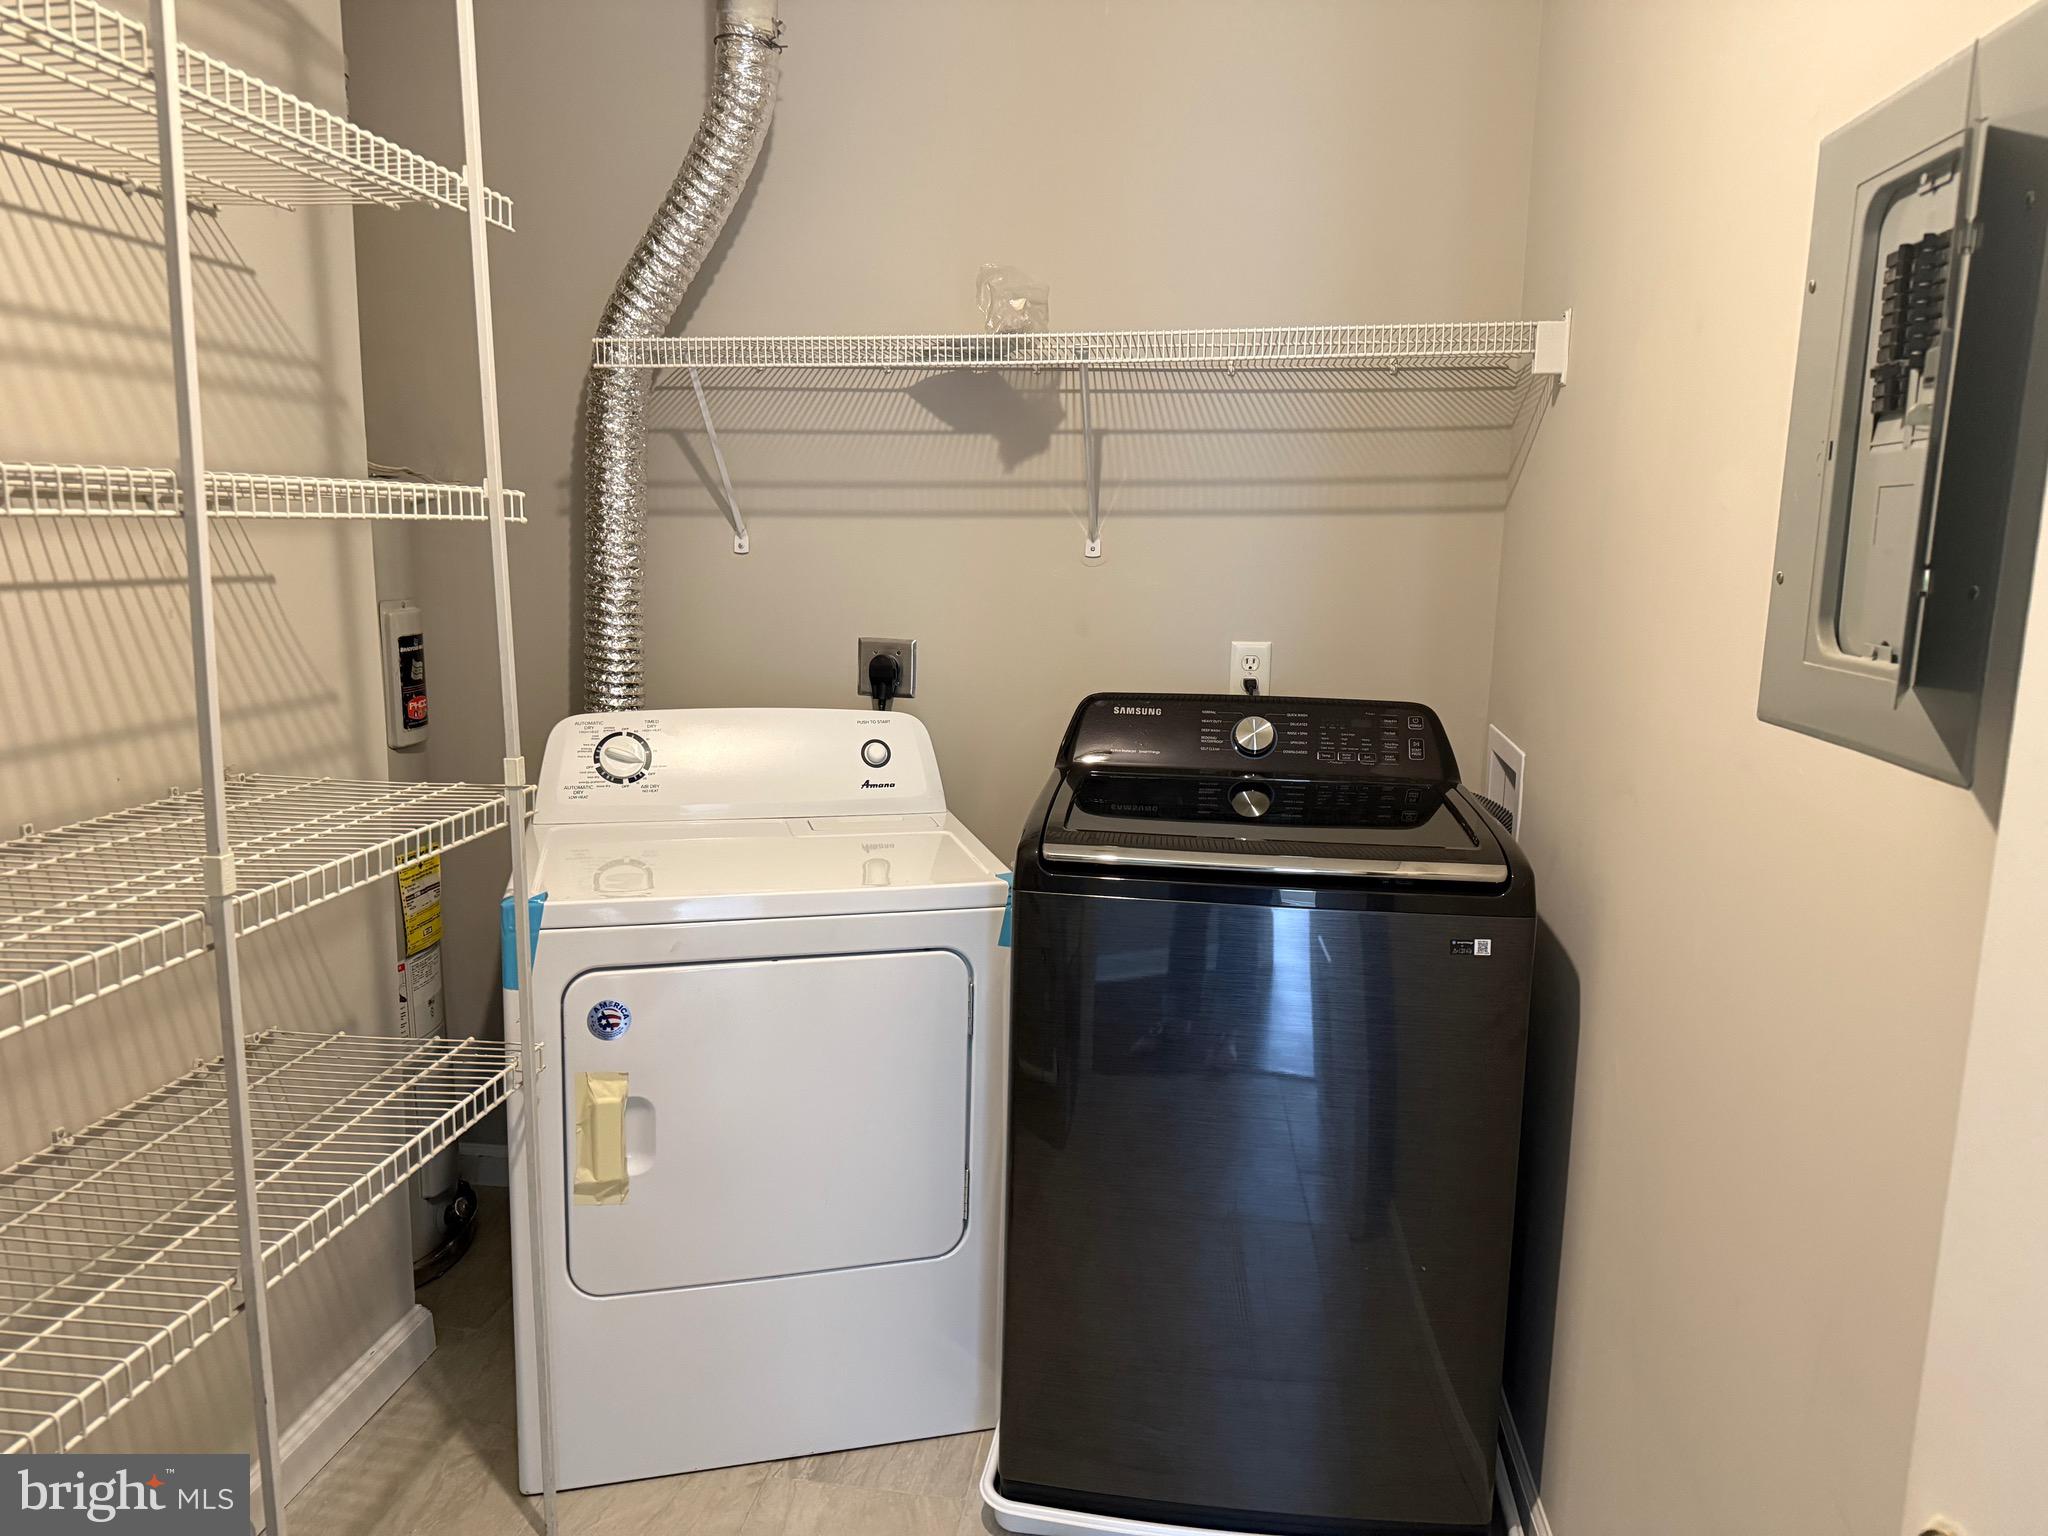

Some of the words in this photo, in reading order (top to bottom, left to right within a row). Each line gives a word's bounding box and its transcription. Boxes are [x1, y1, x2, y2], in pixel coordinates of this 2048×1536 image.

[1113, 706, 1162, 716] SAMSUNG
[861, 780, 895, 789] Amana
[594, 1001, 629, 1020] AMERICA
